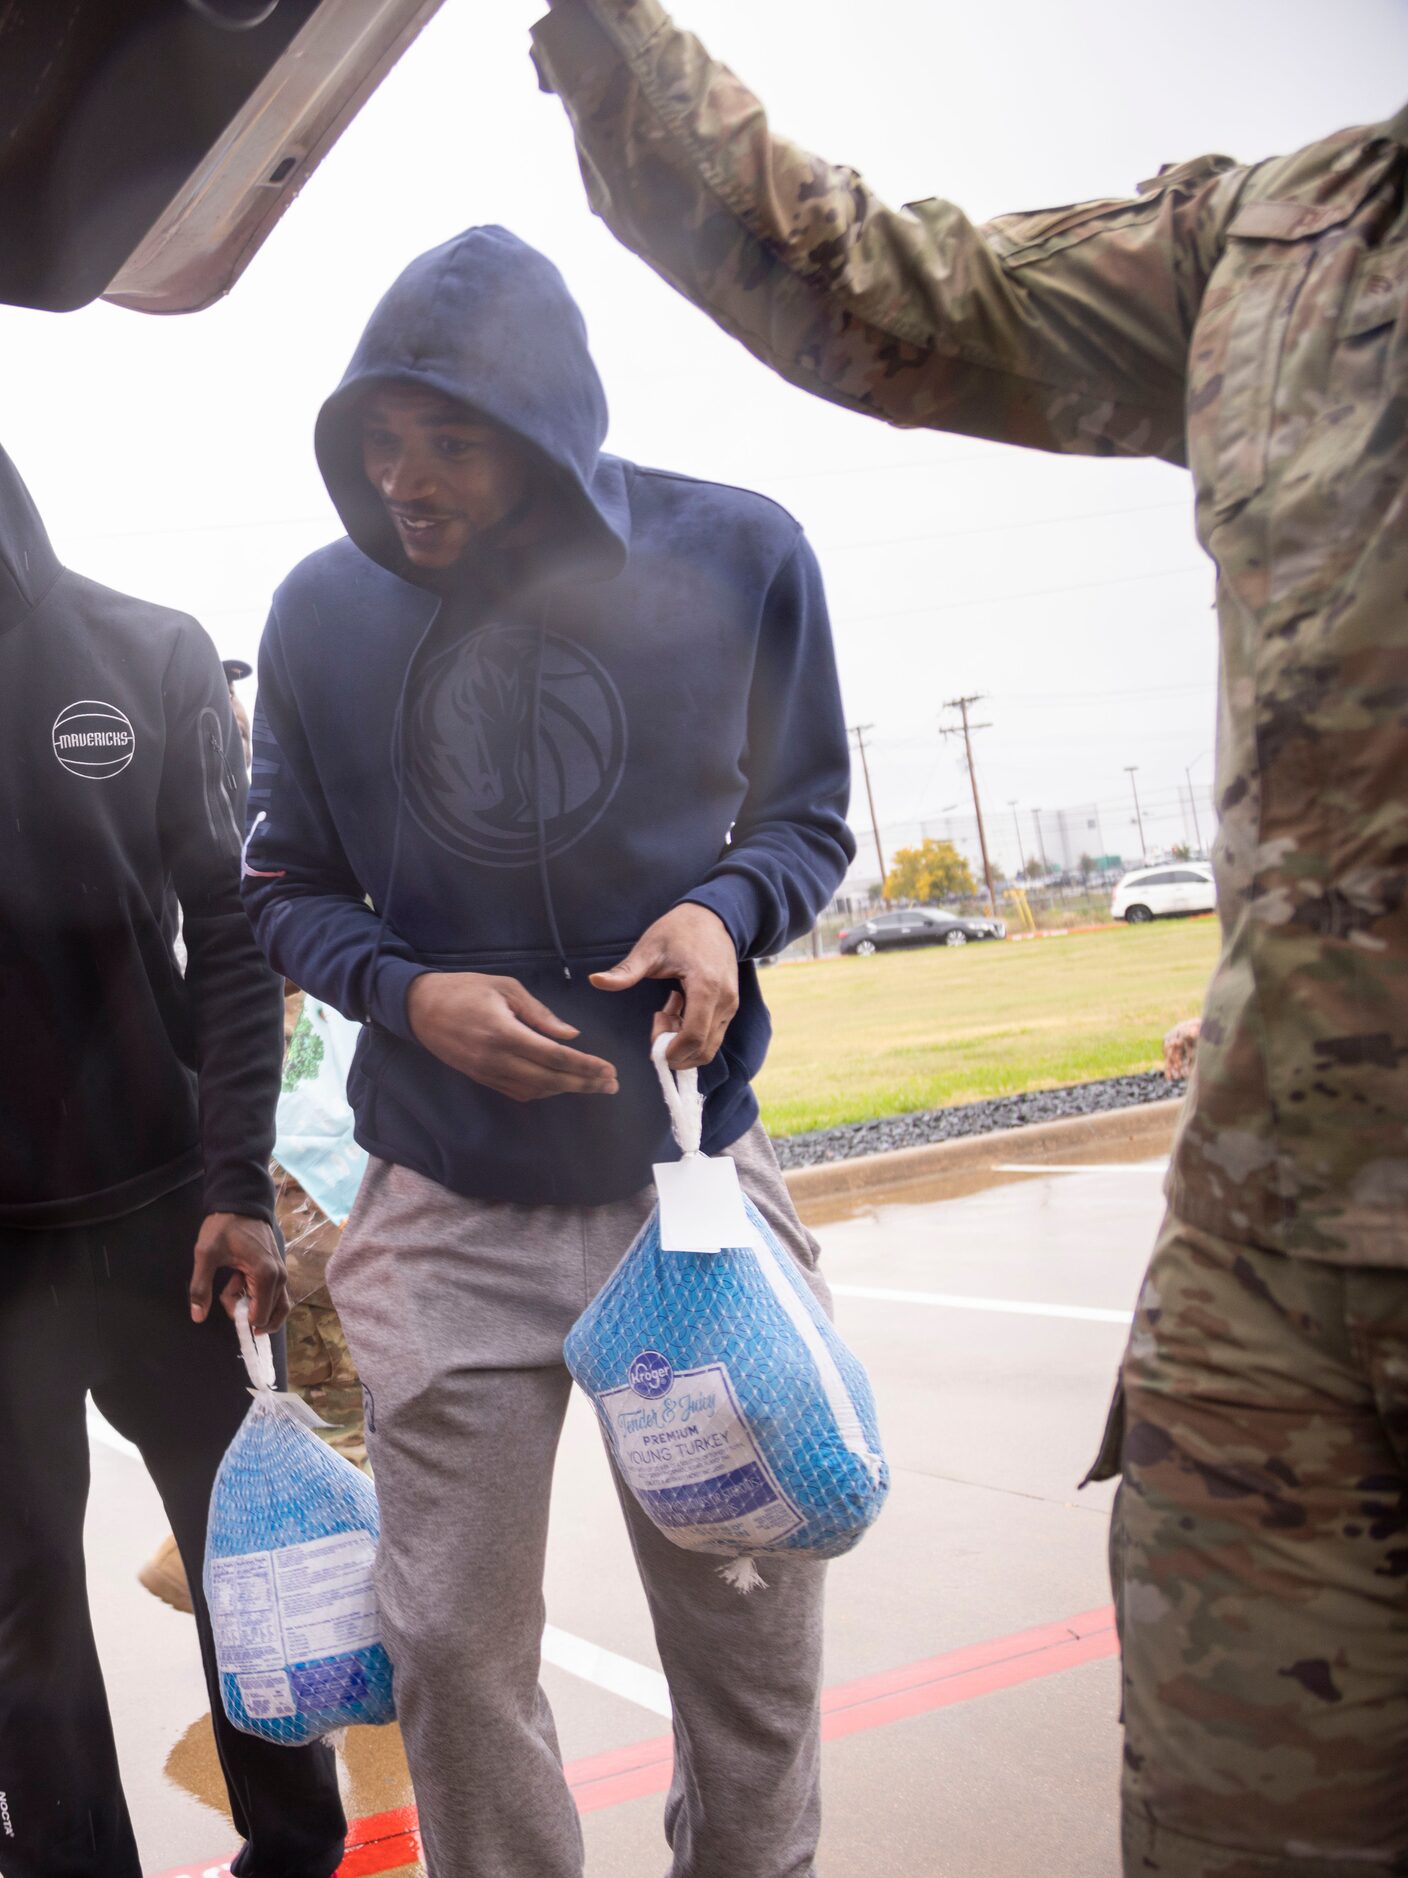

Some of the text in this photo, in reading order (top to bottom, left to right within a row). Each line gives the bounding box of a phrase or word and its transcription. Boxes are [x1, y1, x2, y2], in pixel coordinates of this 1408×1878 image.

[59, 731, 129, 749] MAVERICKS
[631, 1363, 670, 1388] Kroger
[618, 1391, 716, 1438] Tender & Juicy
[628, 1430, 729, 1464] YOUNG TURKEY
[643, 1425, 699, 1446] PREMIUM
